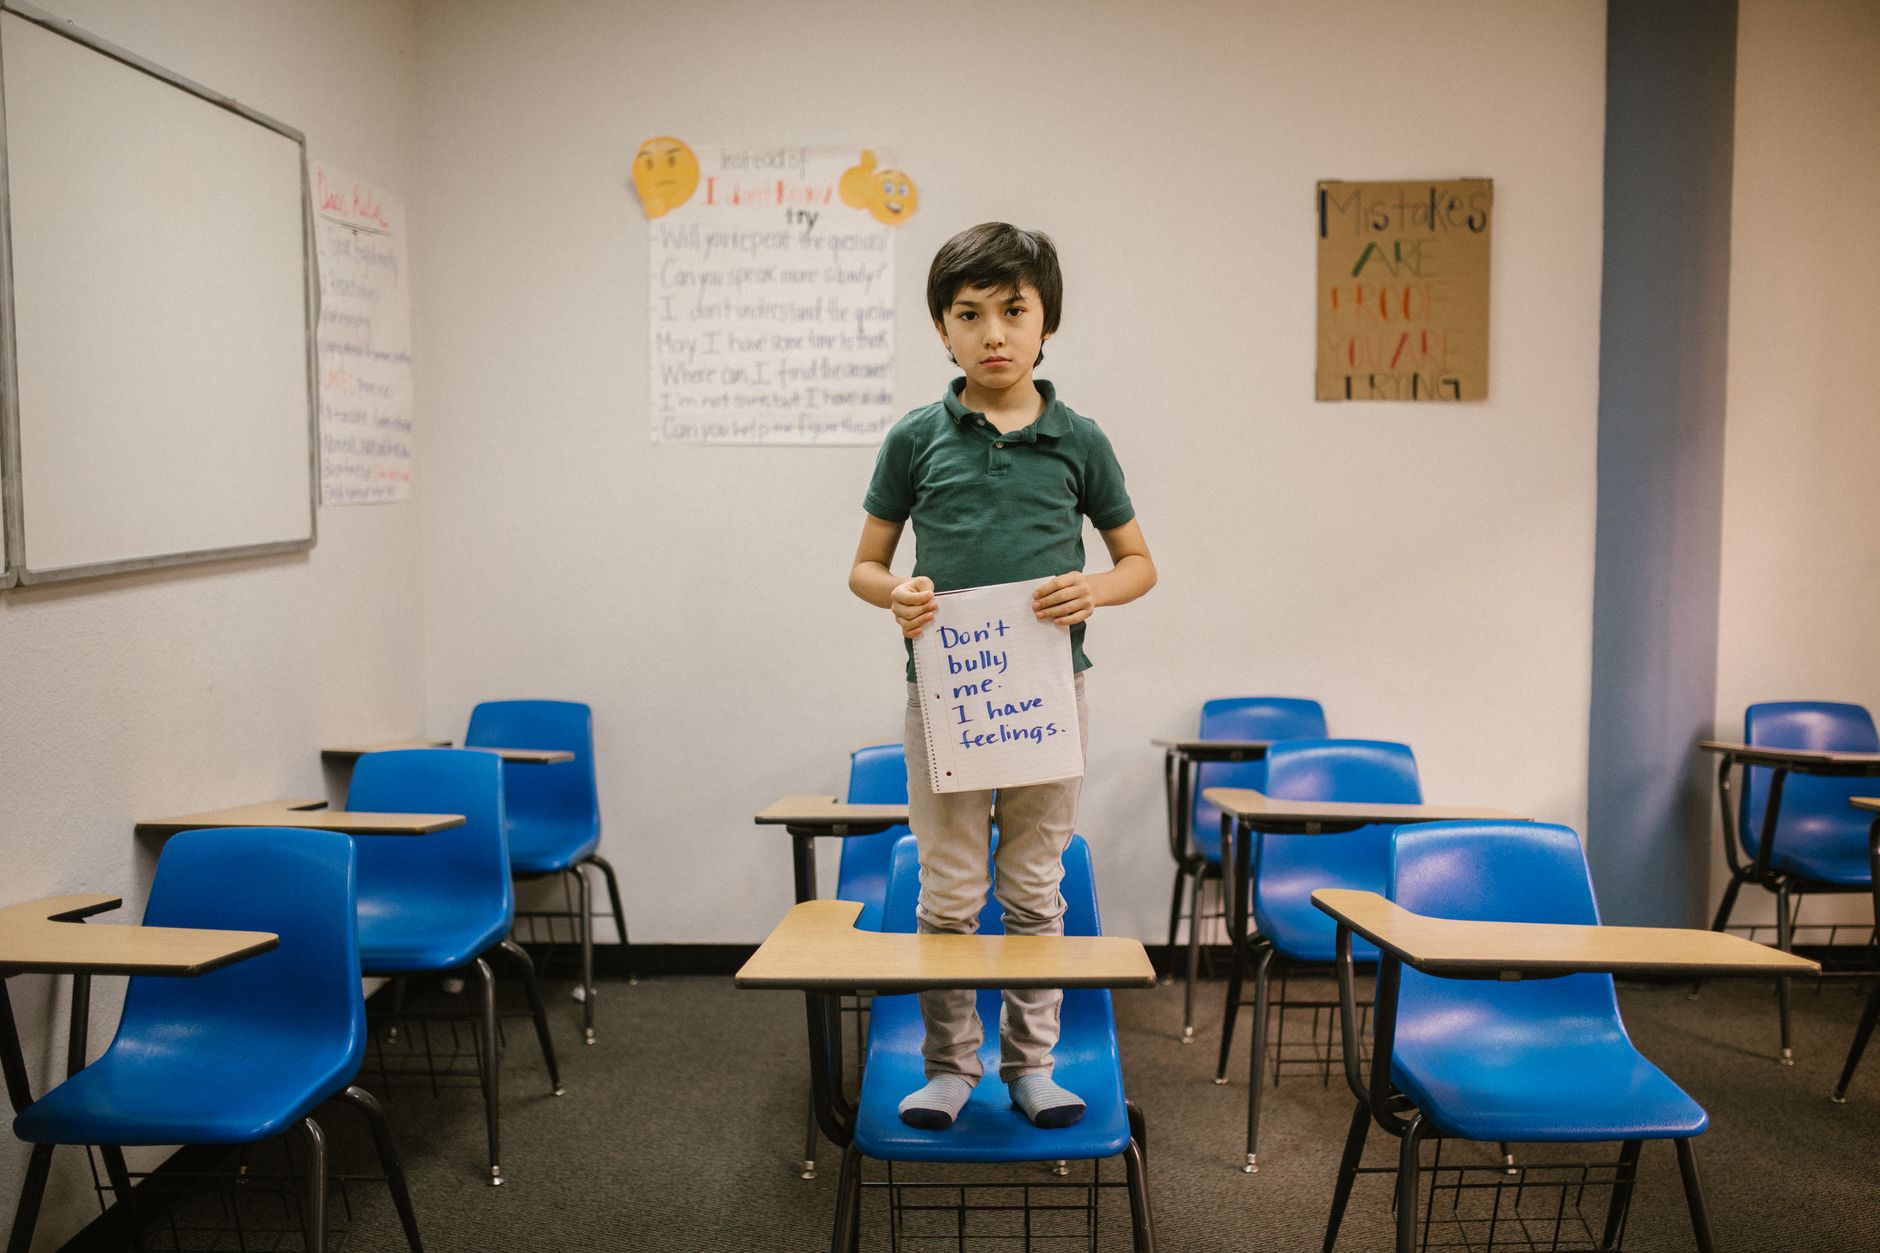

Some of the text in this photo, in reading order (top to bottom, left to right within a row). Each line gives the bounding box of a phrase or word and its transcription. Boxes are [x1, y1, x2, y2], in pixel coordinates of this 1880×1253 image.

[701, 177, 722, 206] I
[1321, 187, 1487, 239] Mistakes
[1350, 236, 1441, 279] ARE
[660, 258, 696, 289] Can
[659, 294, 680, 323] I
[655, 331, 696, 363] May
[702, 331, 722, 355] I
[727, 332, 765, 352] have
[659, 362, 717, 386] Where
[751, 361, 771, 386] I
[1330, 371, 1461, 401] TRYING
[805, 387, 820, 409] I
[660, 416, 702, 440] Can
[703, 423, 731, 443] you
[936, 619, 1011, 649] Don't
[946, 650, 1008, 675] bully
[952, 678, 1003, 700] me.
[952, 696, 1044, 725] I have
[959, 722, 1067, 749] feelings.
